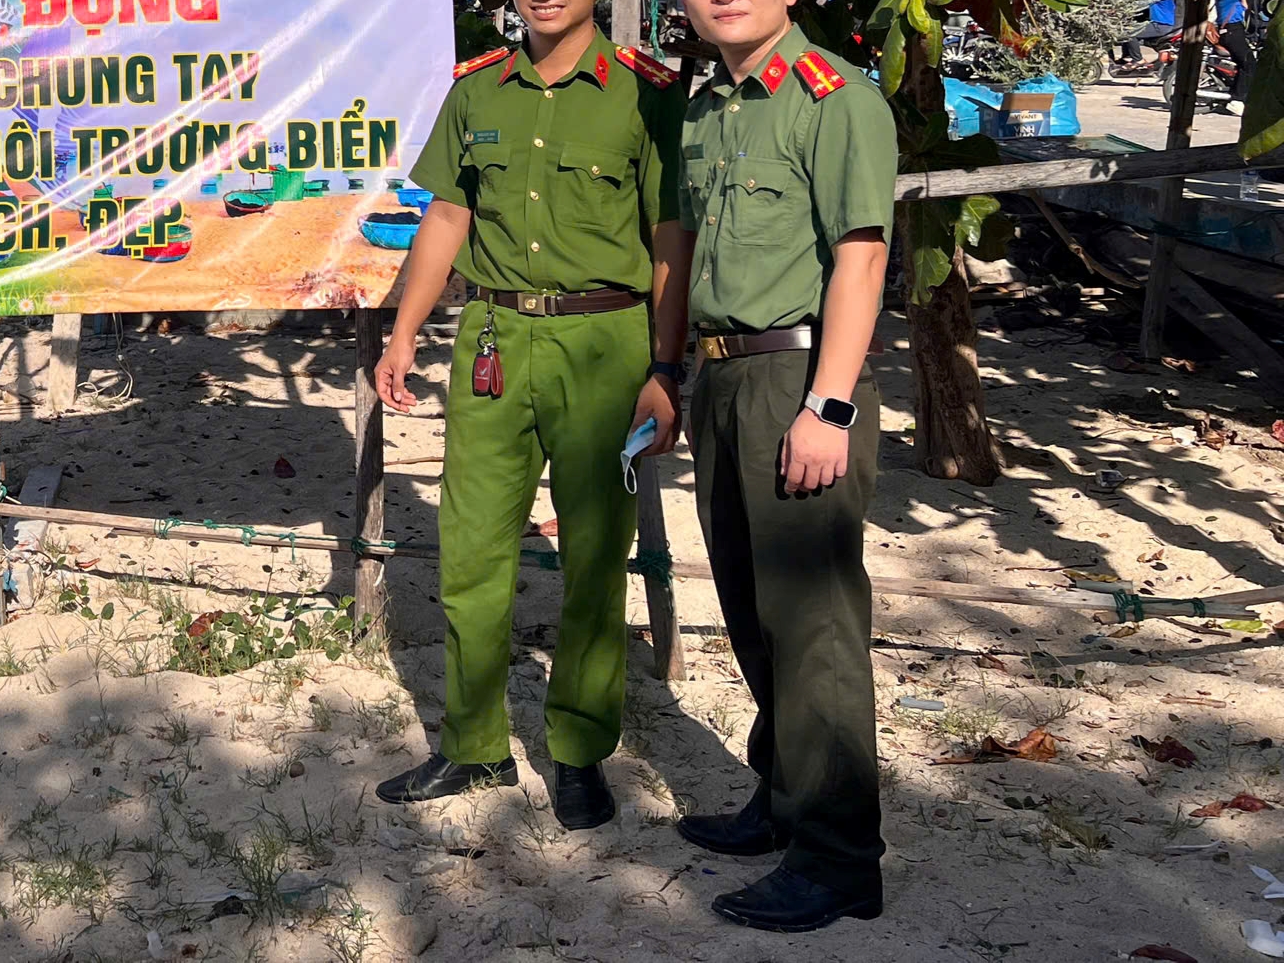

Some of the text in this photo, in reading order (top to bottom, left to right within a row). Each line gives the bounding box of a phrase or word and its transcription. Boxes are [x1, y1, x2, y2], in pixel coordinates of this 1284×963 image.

[172, 50, 261, 104] TAY
[70, 113, 269, 177] TRƯỜNG
[287, 97, 401, 172] BIỂN
[85, 195, 185, 260] ĐẸP
